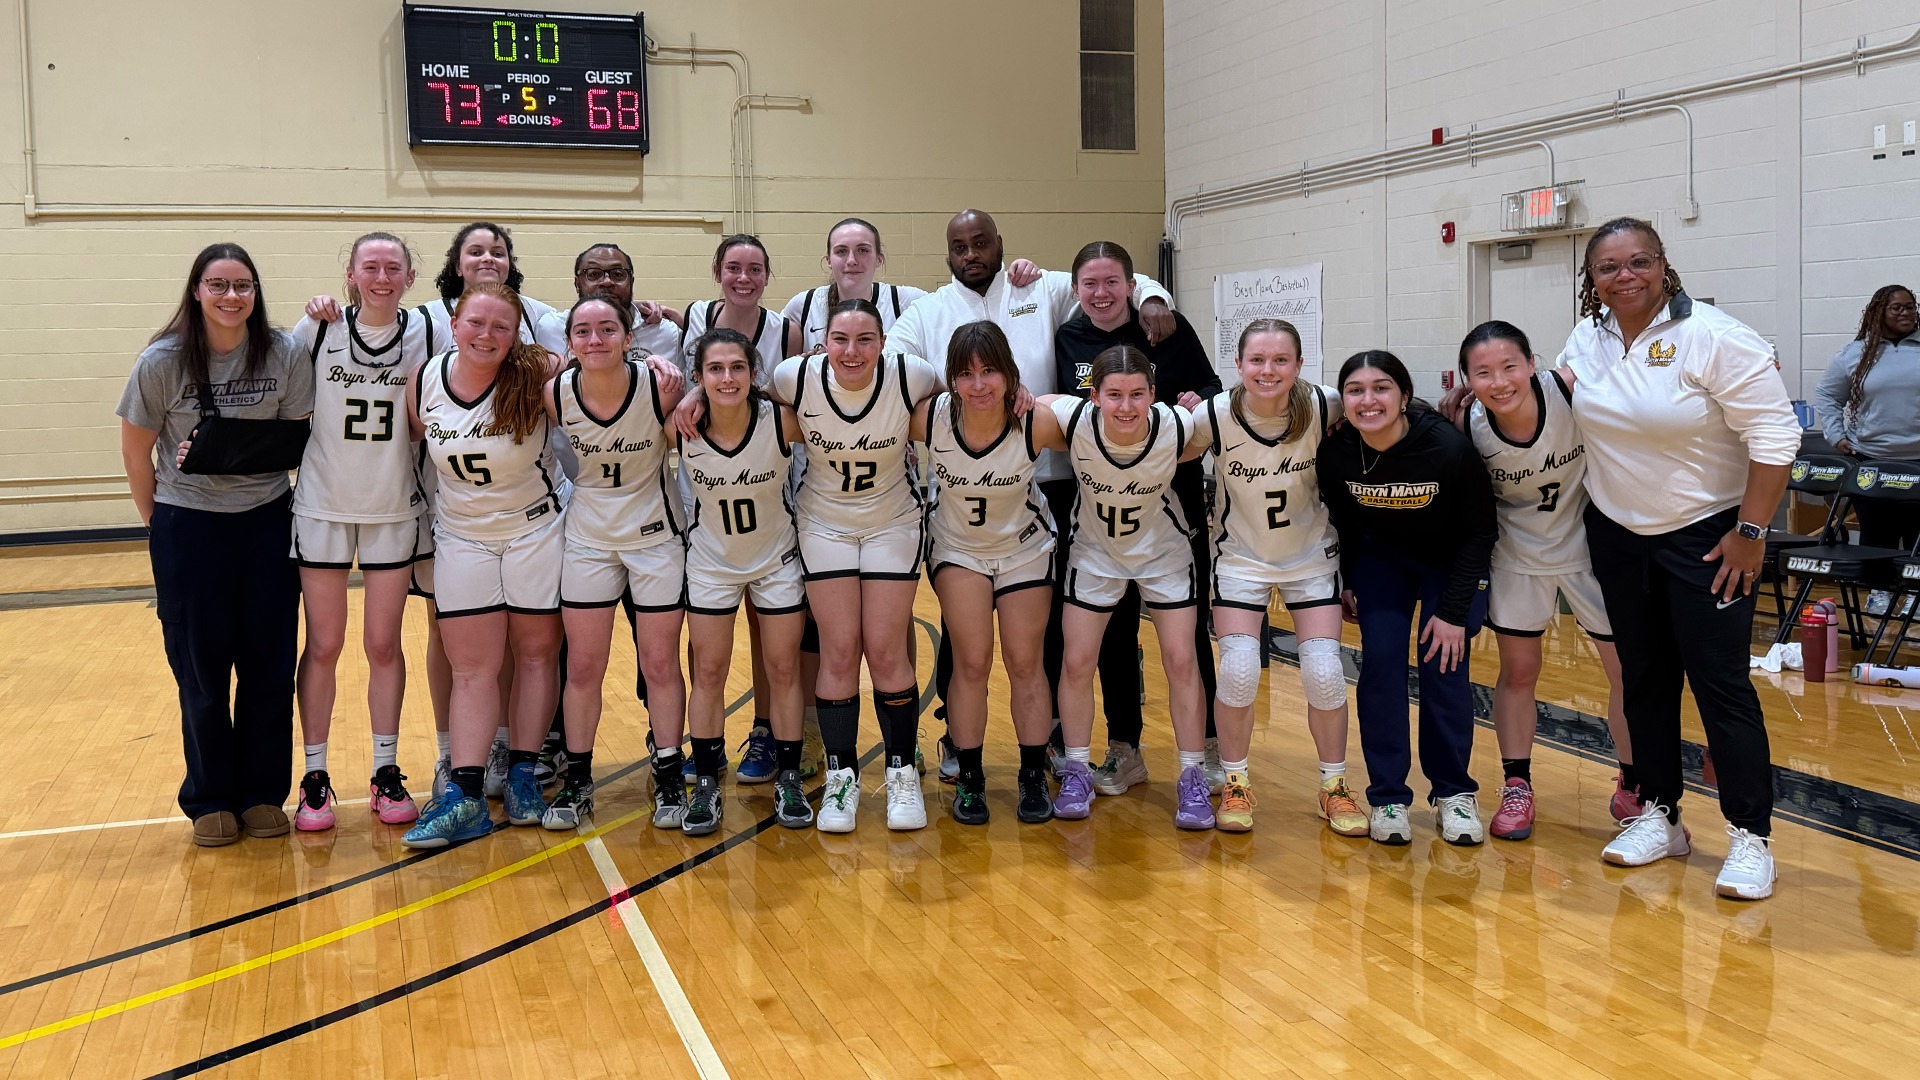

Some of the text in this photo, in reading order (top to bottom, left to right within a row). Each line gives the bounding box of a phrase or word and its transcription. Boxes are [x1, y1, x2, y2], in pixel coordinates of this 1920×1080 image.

[493, 20, 559, 63] 0:0
[421, 64, 470, 78] HOME
[507, 73, 550, 84] PERIOD
[585, 71, 632, 84] GUEST
[427, 82, 481, 125] 73
[502, 87, 556, 111] P 5 P
[587, 88, 639, 130] 68
[508, 114, 551, 125] BONUS
[1529, 189, 1553, 217] EXIT
[184, 379, 276, 398] BYN MAWR
[326, 366, 408, 389] Bryn Maw
[214, 396, 255, 405] THLETICS
[344, 398, 394, 441] 23
[429, 422, 459, 445] Bryn
[570, 434, 653, 457] Bryn Mawr
[808, 430, 897, 453] Bryn Mawr
[447, 453, 492, 487] 15
[601, 463, 621, 487] 4
[829, 460, 877, 492] 42
[936, 463, 1021, 488] Bryn Mawr
[1228, 460, 1268, 483] Bryn
[1491, 444, 1586, 485] Bryn Mawr
[693, 468, 776, 490] Bryn Mawr
[1080, 471, 1163, 495] Bryn Mawr
[1351, 484, 1436, 497] BRYN MAWR
[965, 497, 987, 527] 3
[1265, 490, 1290, 530] 2
[1367, 498, 1423, 506] BASKETBALL
[719, 499, 757, 535] 10
[1096, 501, 1142, 538] 45
[1787, 557, 1832, 574] OWLS
